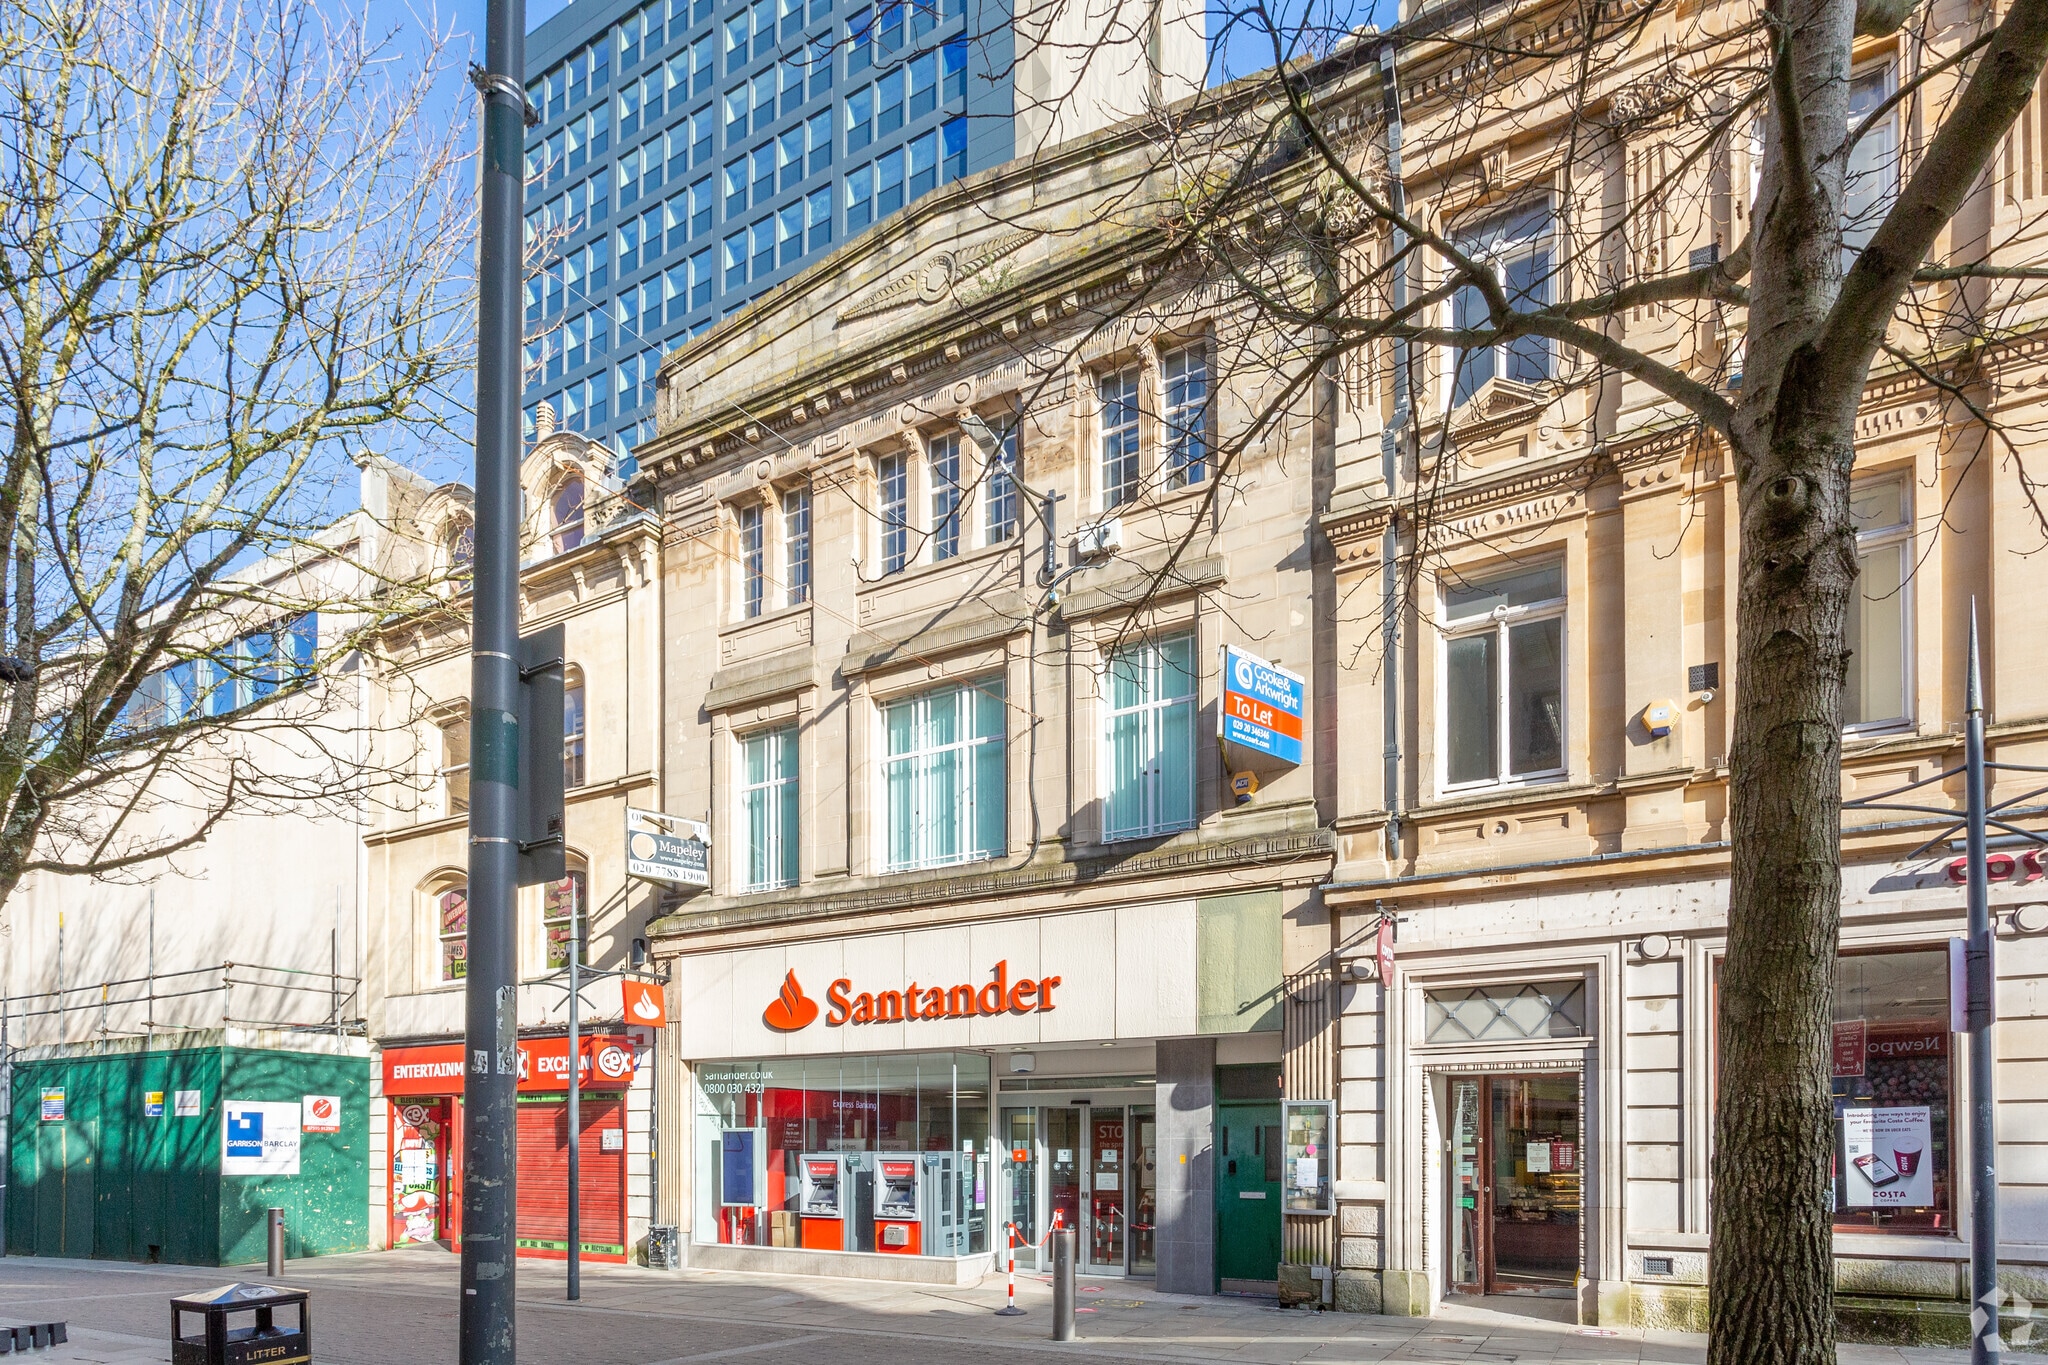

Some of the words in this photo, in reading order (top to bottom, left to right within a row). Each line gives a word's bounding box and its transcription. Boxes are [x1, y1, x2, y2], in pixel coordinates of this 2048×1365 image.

[1254, 680, 1298, 710] Arkwright
[1234, 696, 1250, 718] To
[1253, 703, 1272, 726] Let
[1233, 719, 1243, 731] 029
[1244, 723, 1250, 733] 20
[1251, 726, 1270, 740] 346346
[1235, 779, 1248, 789] ADT
[659, 840, 704, 861] Mapeley
[660, 855, 705, 868] www.mapeley.com
[633, 862, 652, 873] 020
[656, 865, 679, 878] 7788
[682, 870, 705, 881] 1900
[827, 959, 1062, 1025] Santander
[704, 1071, 773, 1081] santander.couk
[704, 1083, 725, 1094] 0800
[727, 1083, 743, 1094] 030
[744, 1083, 765, 1094] 4321
[832, 1099, 854, 1108] Express
[855, 1100, 877, 1112] Banking
[1099, 1125, 1123, 1138] STO
[227, 1140, 263, 1148] GARRISON
[264, 1140, 298, 1148] BARCLAY
[1872, 1190, 1906, 1198] COSTA
[246, 1346, 286, 1361] LITTER
